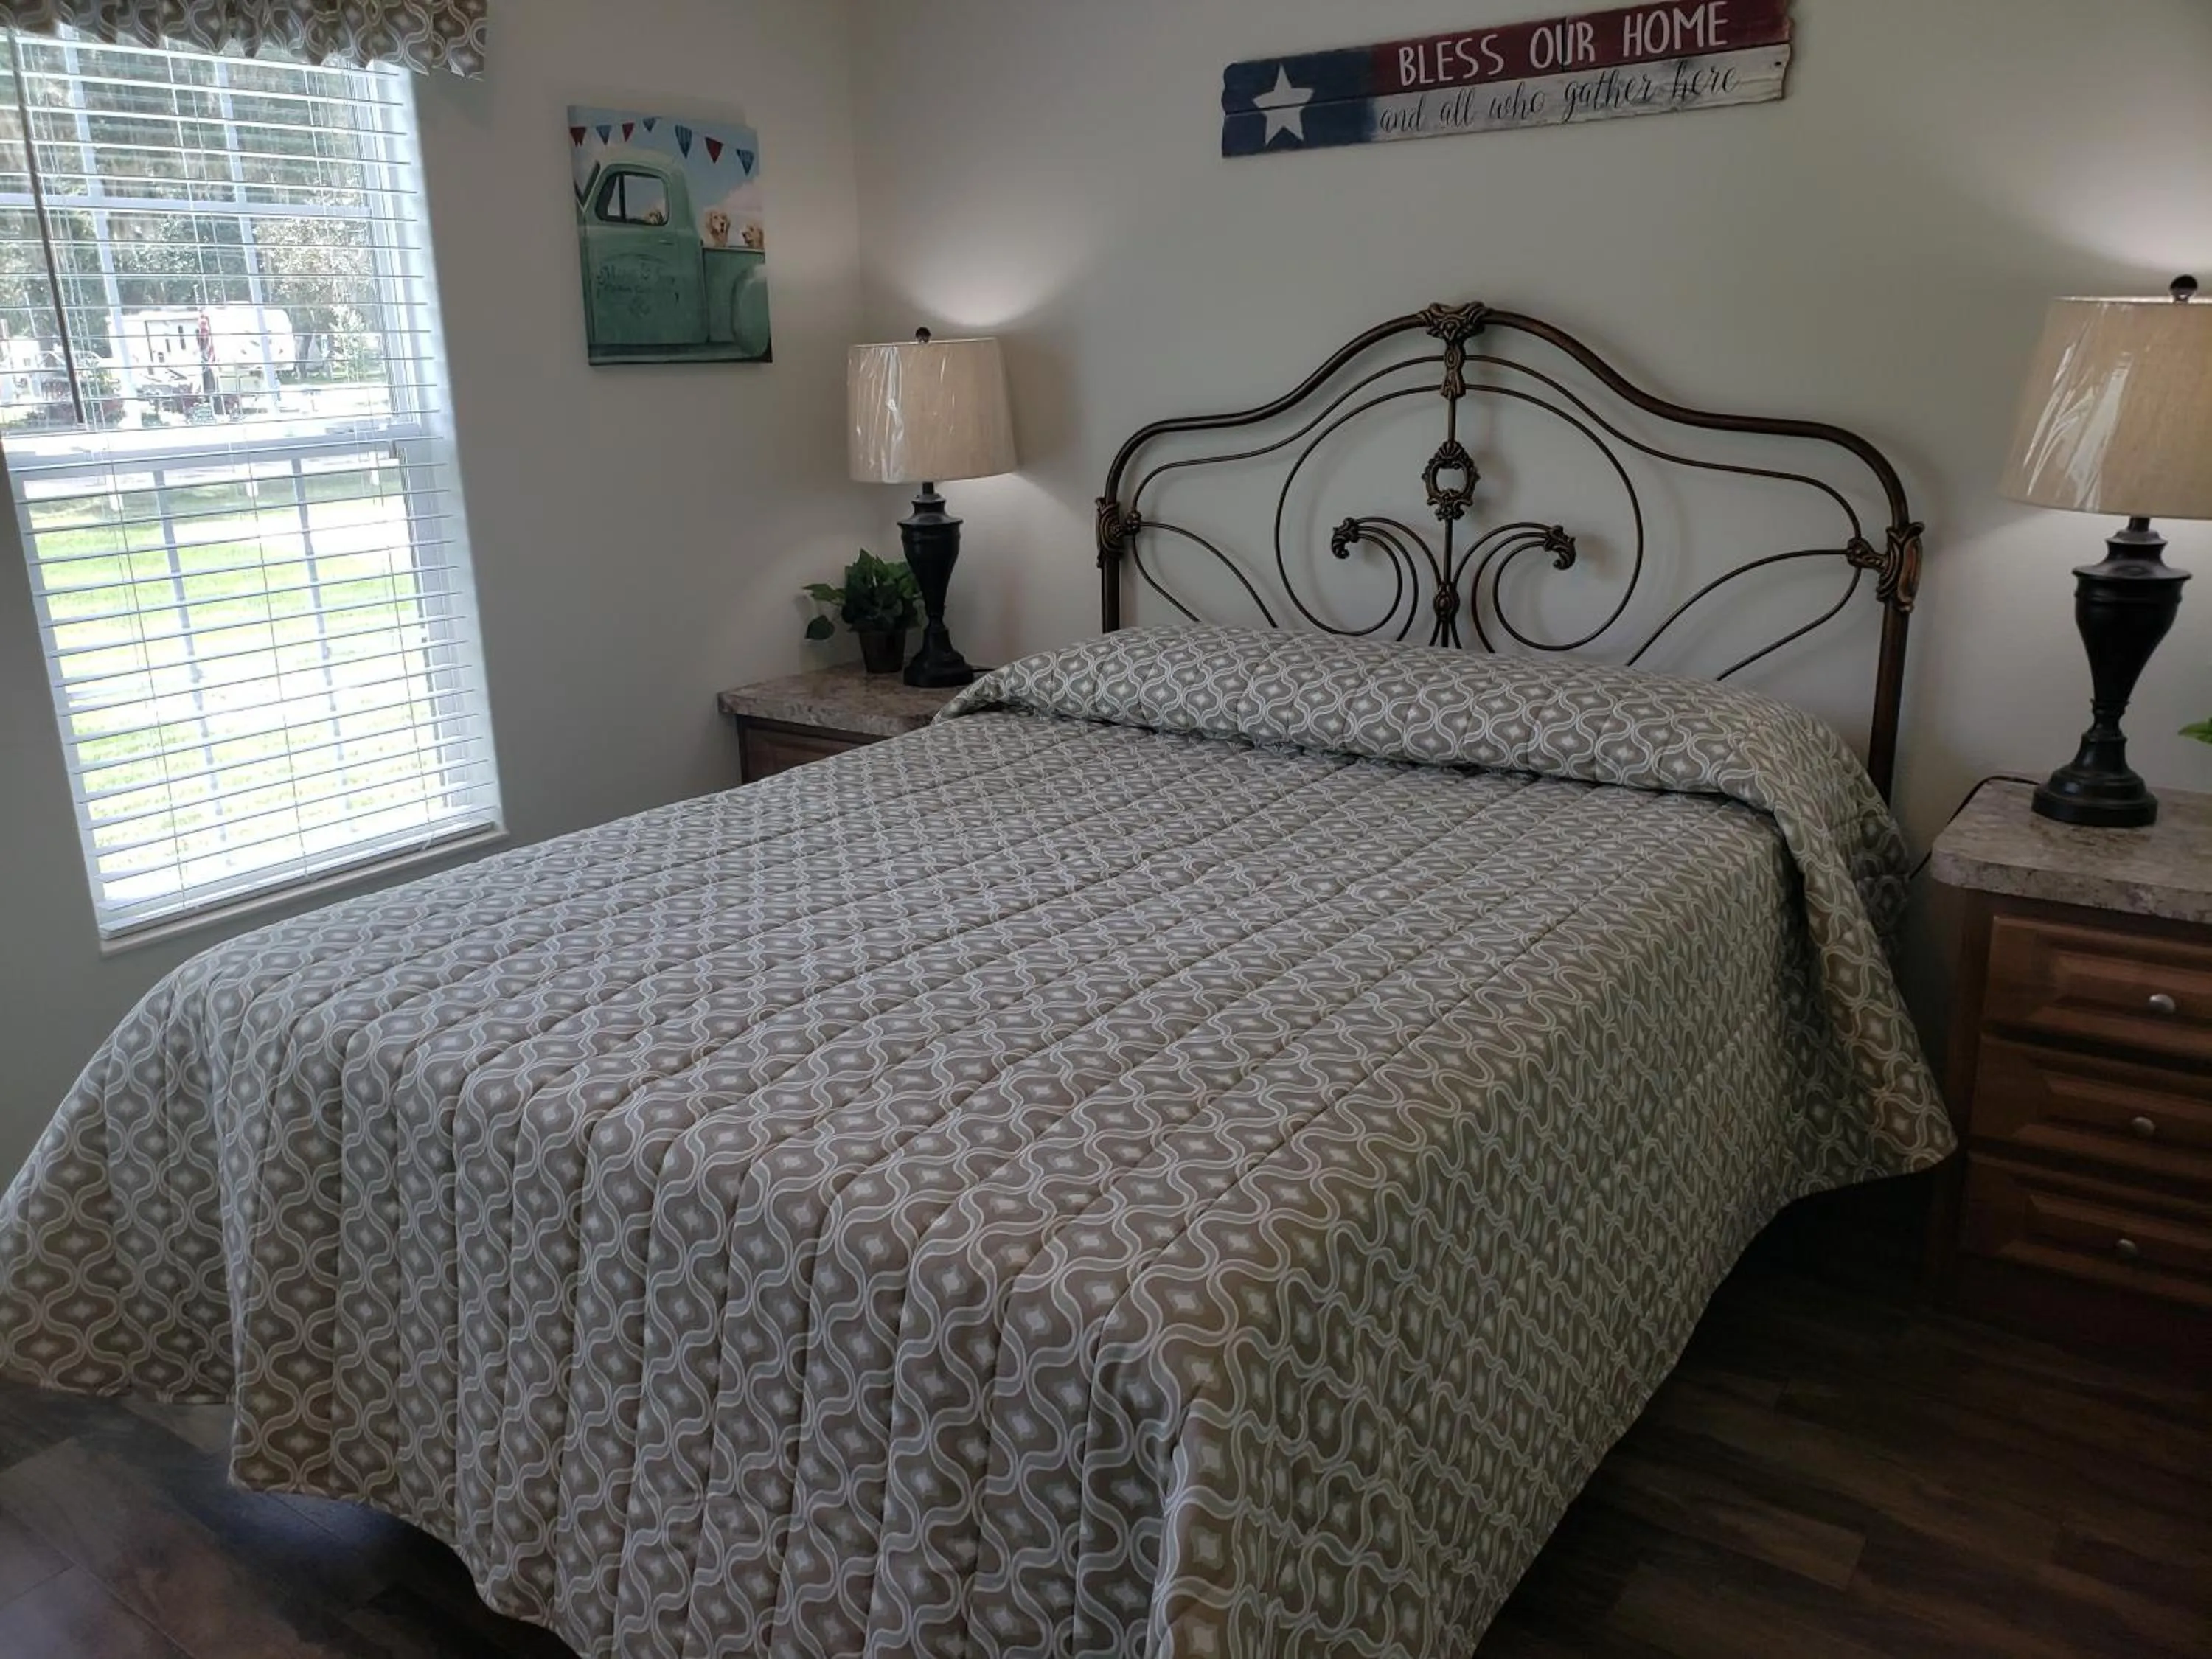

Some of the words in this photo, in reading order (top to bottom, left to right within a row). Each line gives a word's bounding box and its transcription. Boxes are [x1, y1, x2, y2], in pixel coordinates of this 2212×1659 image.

[1399, 34, 1505, 86] BLESS
[1529, 21, 1596, 69] OUR
[1622, 1, 1728, 57] HOME
[1380, 96, 1426, 133] and
[1440, 88, 1475, 128] all
[1489, 81, 1545, 121] who
[1559, 68, 1654, 125] gather
[1672, 59, 1739, 102] here
